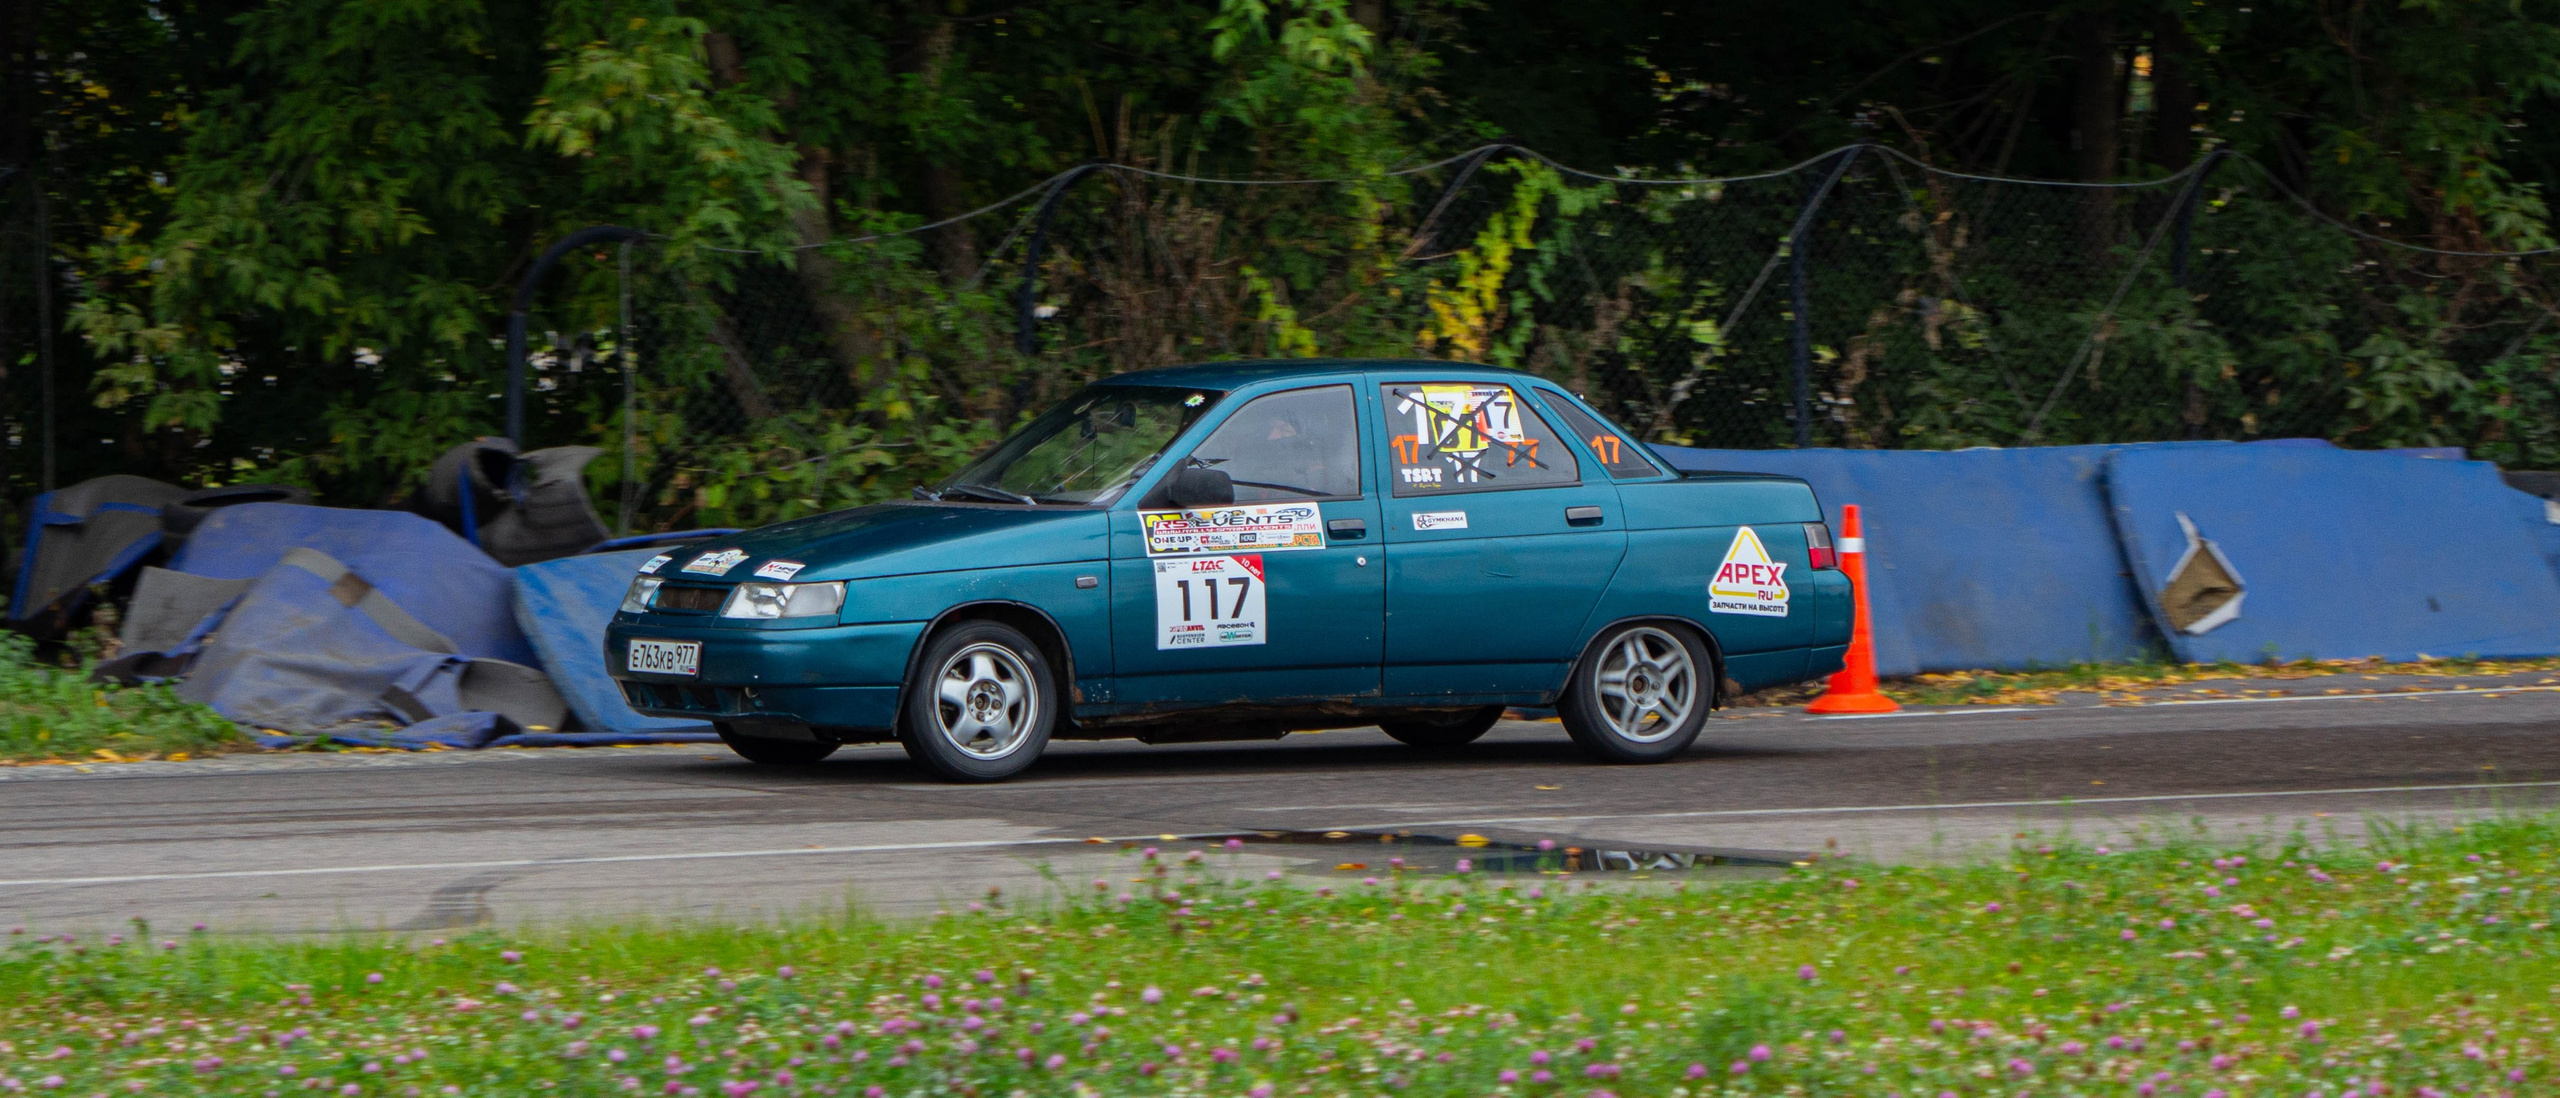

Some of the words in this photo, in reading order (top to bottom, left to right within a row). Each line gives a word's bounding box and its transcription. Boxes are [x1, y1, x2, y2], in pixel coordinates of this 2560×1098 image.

[1391, 435, 1420, 464] 17
[1591, 435, 1620, 464] 17
[1401, 468, 1442, 483] TSRT
[1156, 520, 1188, 528] RS
[1195, 514, 1293, 527] EVENTS
[1428, 516, 1464, 524] GYMKHANA
[1192, 559, 1225, 572] LTAC
[1241, 557, 1250, 568] 10
[1716, 563, 1782, 586] APEX
[1177, 577, 1250, 621] 117
[1757, 590, 1774, 601] RU
[1712, 602, 1747, 610] ЗАПЧАСТИ
[1748, 603, 1758, 611] НА
[1759, 604, 1785, 613] ВЫСОТЕ
[1177, 637, 1205, 645] CENTER
[676, 644, 695, 664] 977
